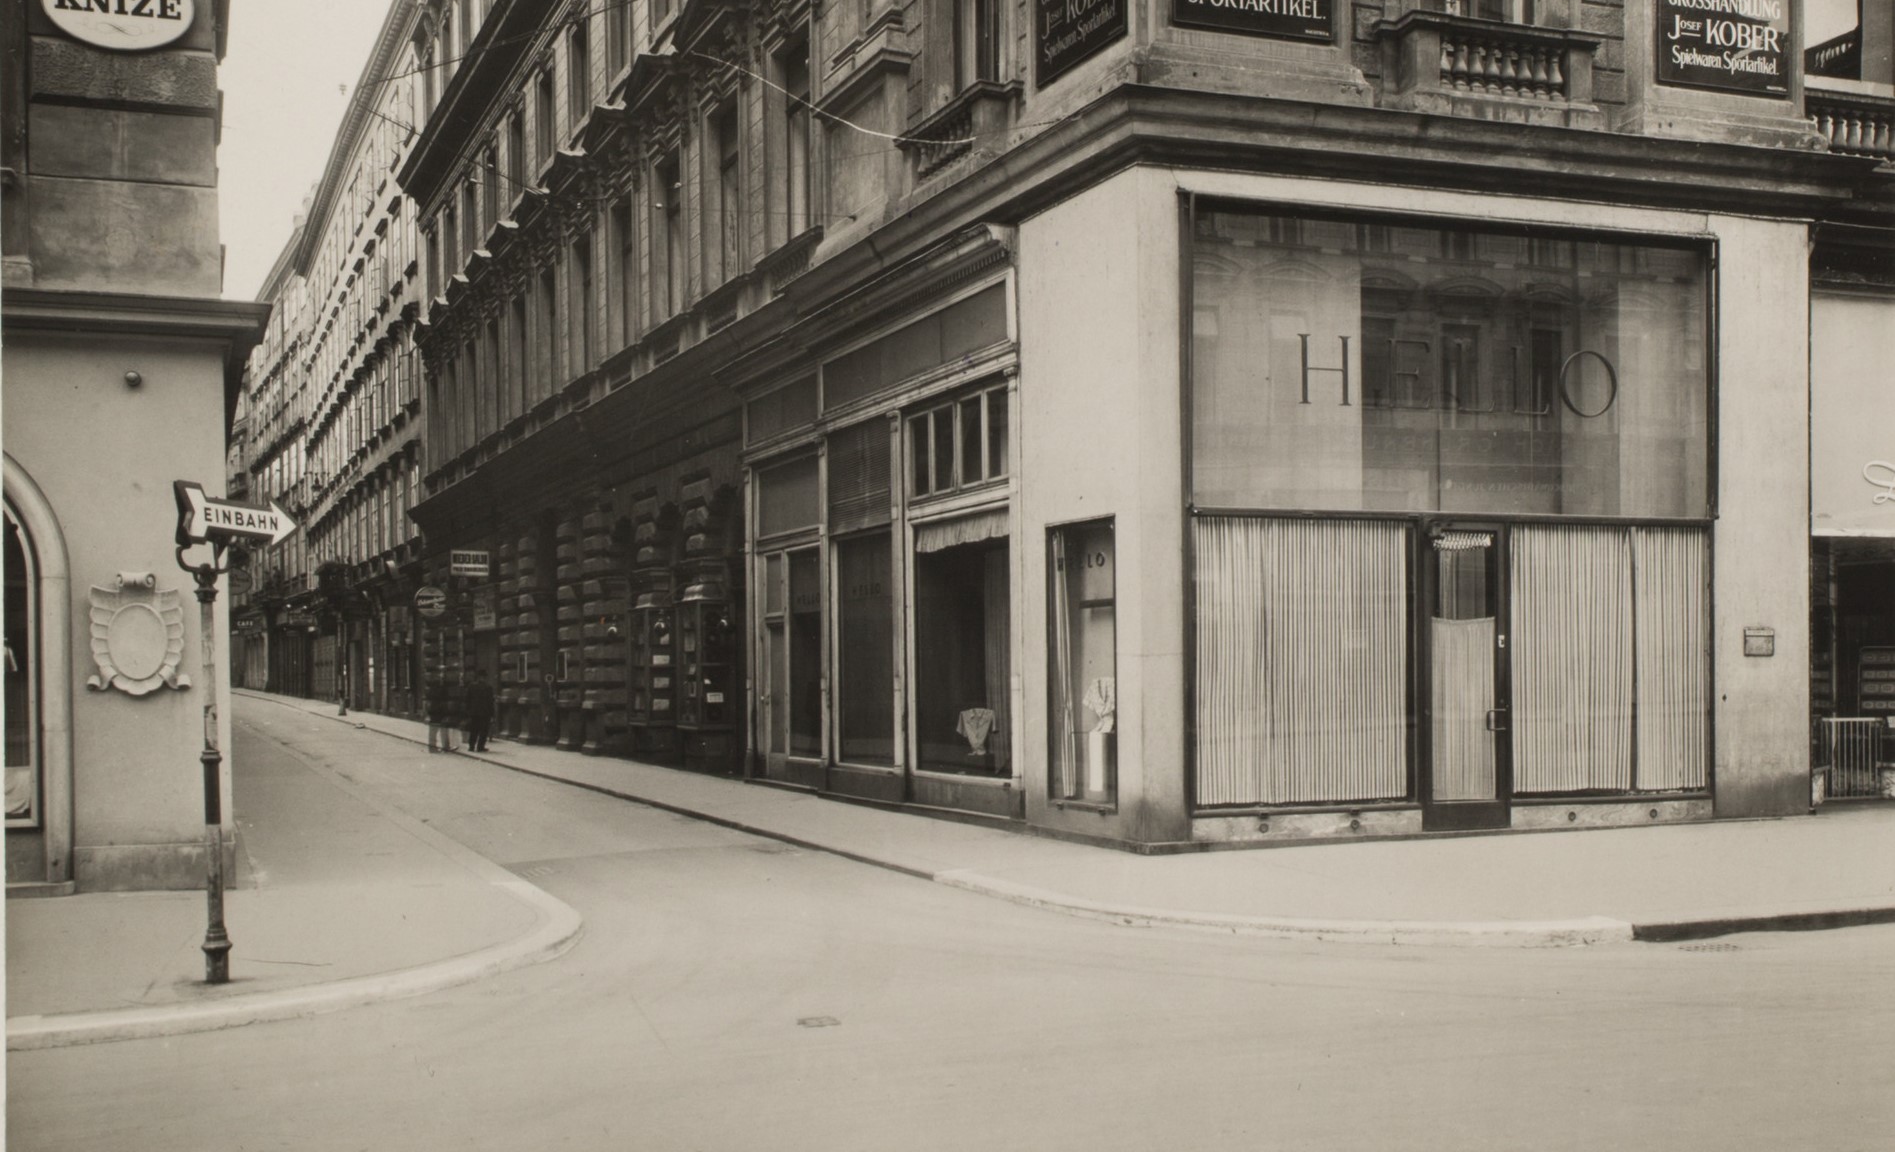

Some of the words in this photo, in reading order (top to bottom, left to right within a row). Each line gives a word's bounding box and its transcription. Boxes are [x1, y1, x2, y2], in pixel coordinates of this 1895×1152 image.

[1706, 18, 1780, 53] KOBER
[1297, 332, 1617, 418] HELLO
[204, 507, 279, 530] EINBAHN
